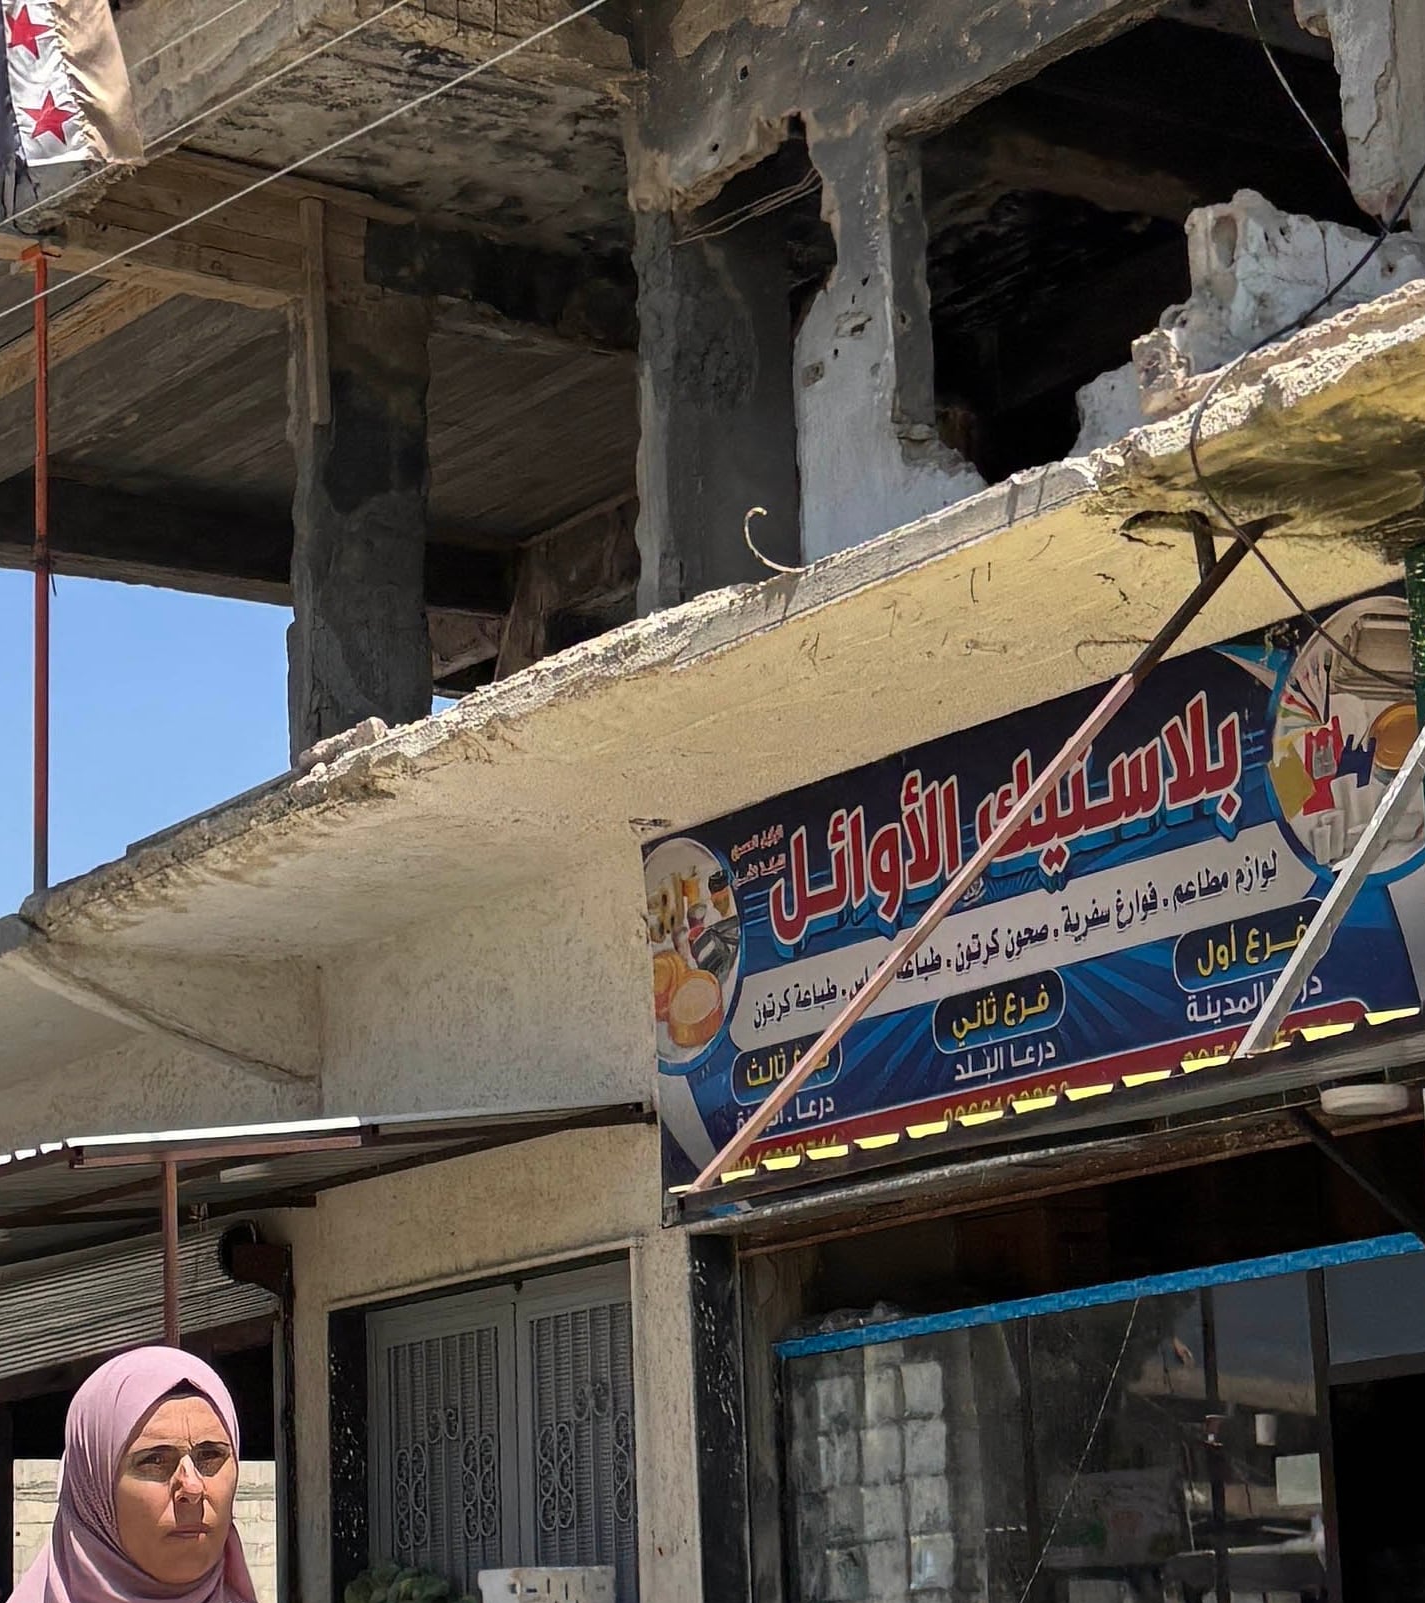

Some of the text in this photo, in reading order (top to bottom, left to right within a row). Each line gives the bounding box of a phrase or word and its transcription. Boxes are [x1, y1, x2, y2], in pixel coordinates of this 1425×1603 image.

[769, 689, 1243, 946] بلاستيك الأوائل
[1173, 866, 1230, 911] مطاعم
[1234, 848, 1278, 893] لوازم
[1061, 898, 1111, 942] سفرية
[1116, 881, 1159, 930] فوارغ
[955, 927, 1000, 973] كرتون
[1005, 922, 1049, 958] صحون
[1197, 915, 1307, 977] فرع أول
[896, 946, 942, 982] طباع
[752, 987, 791, 1029] كرتون
[793, 977, 838, 1010] طباعة
[952, 983, 1050, 1048] فرع ثاني
[1186, 980, 1265, 1024] المدينة
[746, 1048, 786, 1087] ثالث
[954, 1041, 1056, 1080] درعا البلد
[796, 1096, 835, 1121] درعا
